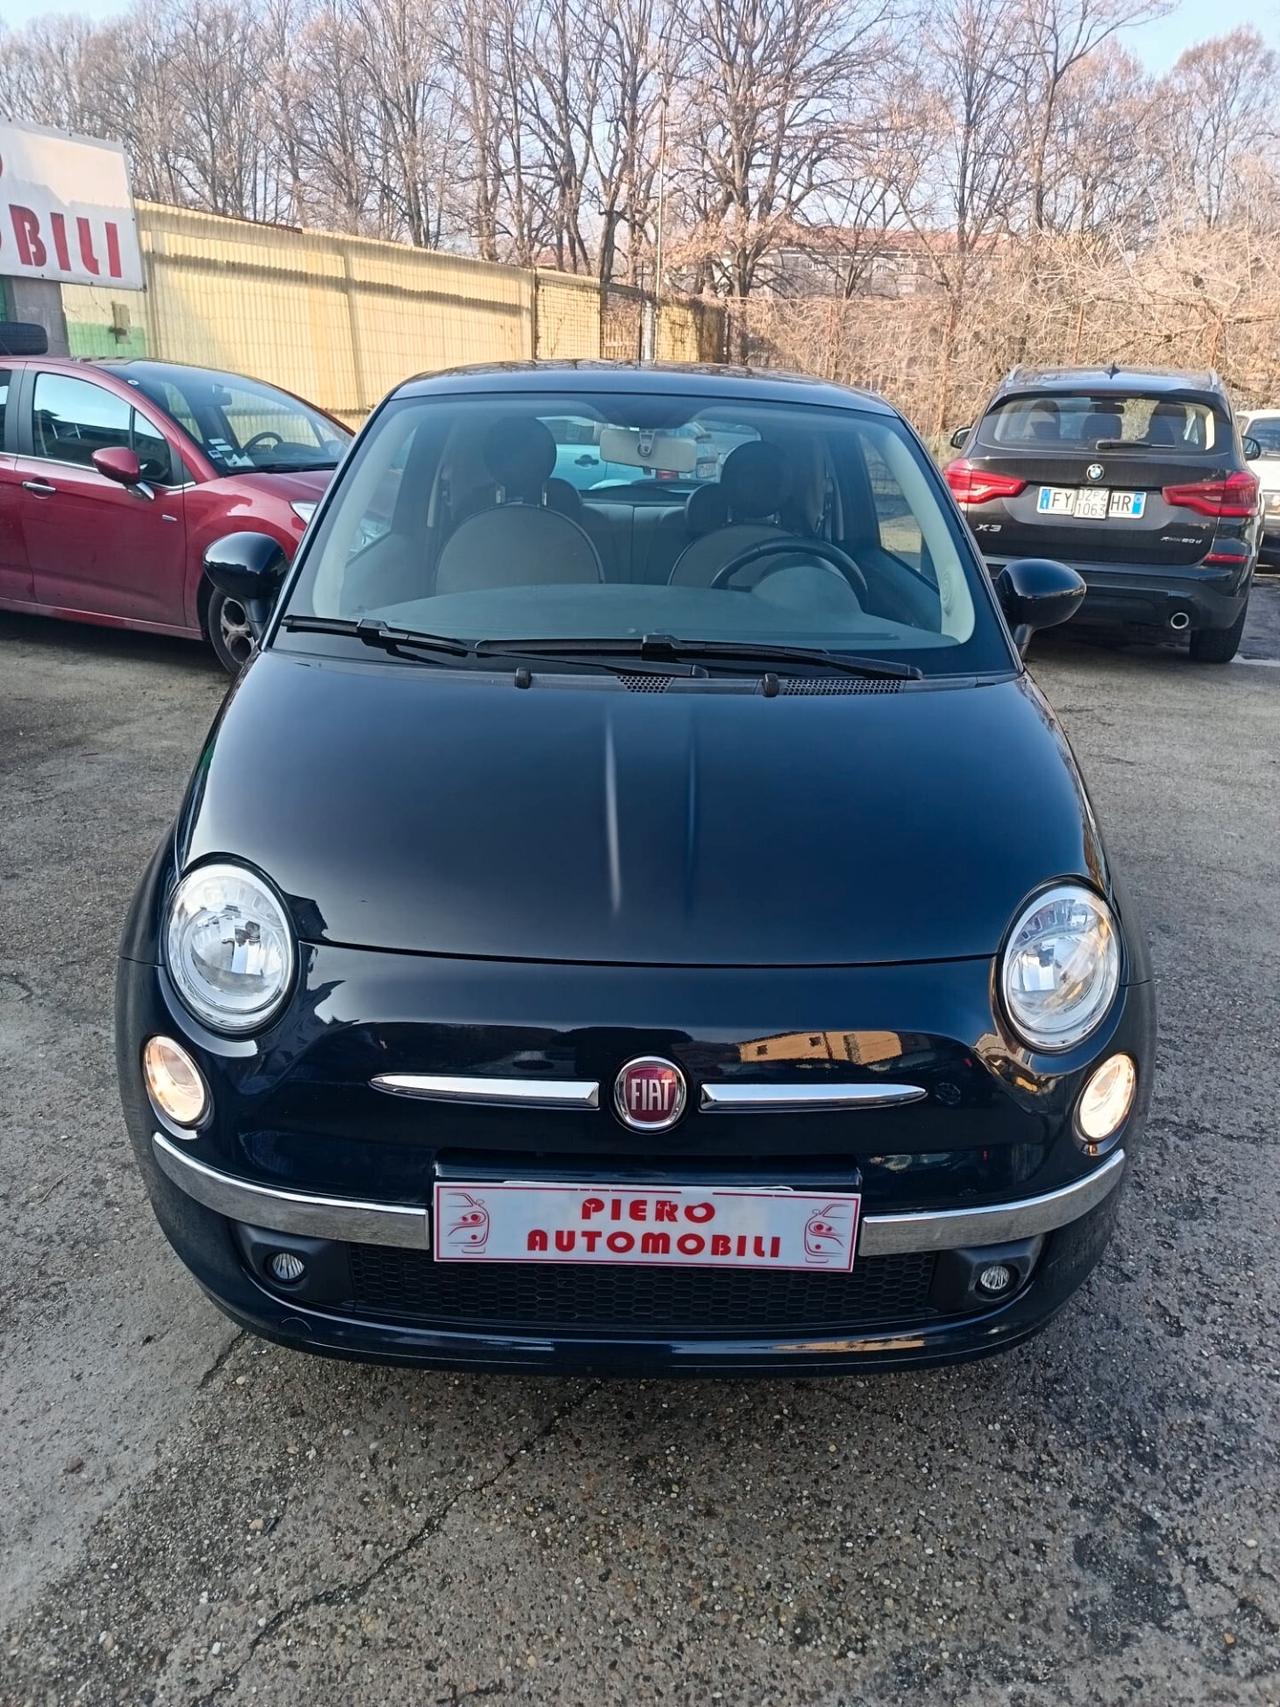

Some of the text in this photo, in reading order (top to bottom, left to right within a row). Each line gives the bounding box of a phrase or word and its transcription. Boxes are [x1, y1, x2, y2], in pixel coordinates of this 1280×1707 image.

[0, 203, 122, 278] BILI
[1051, 492, 1132, 512] FY HR
[975, 523, 1002, 532] X3
[631, 1078, 673, 1111] FIAT
[581, 1197, 716, 1224] PIERO
[527, 1229, 781, 1257] AUTOMOBILI
